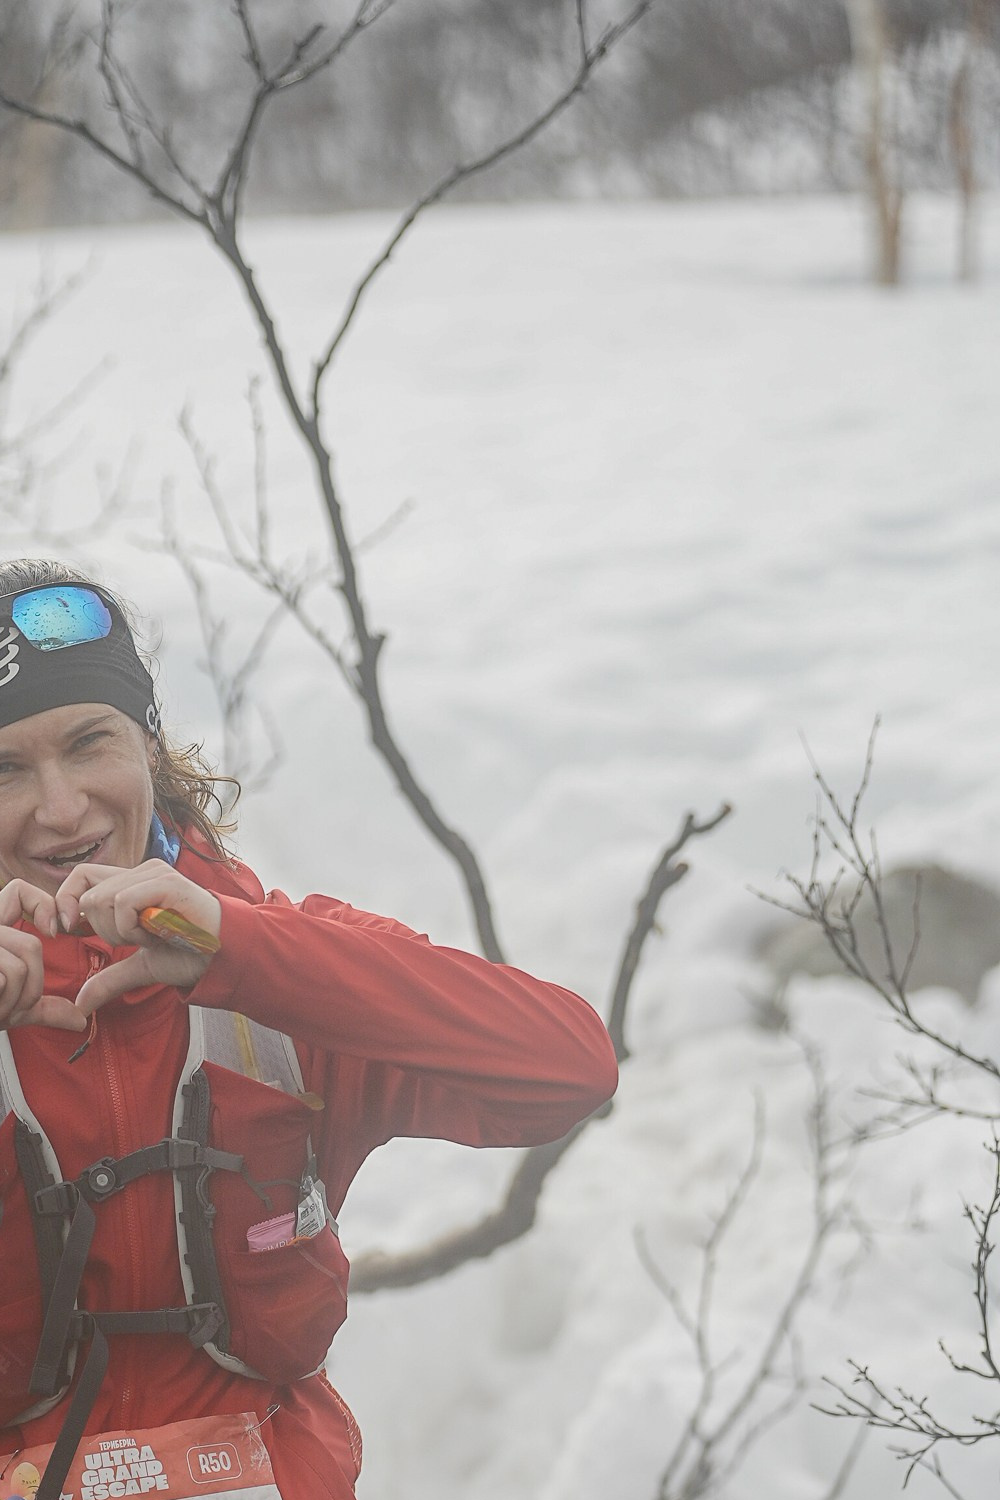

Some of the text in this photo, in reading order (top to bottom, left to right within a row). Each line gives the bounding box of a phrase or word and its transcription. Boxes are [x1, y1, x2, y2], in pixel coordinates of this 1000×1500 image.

[99, 1438, 136, 1451] ТЕРИБЕРКА
[84, 1445, 156, 1470] ULTRA
[198, 1451, 232, 1474] R50
[81, 1460, 163, 1487] GRAND
